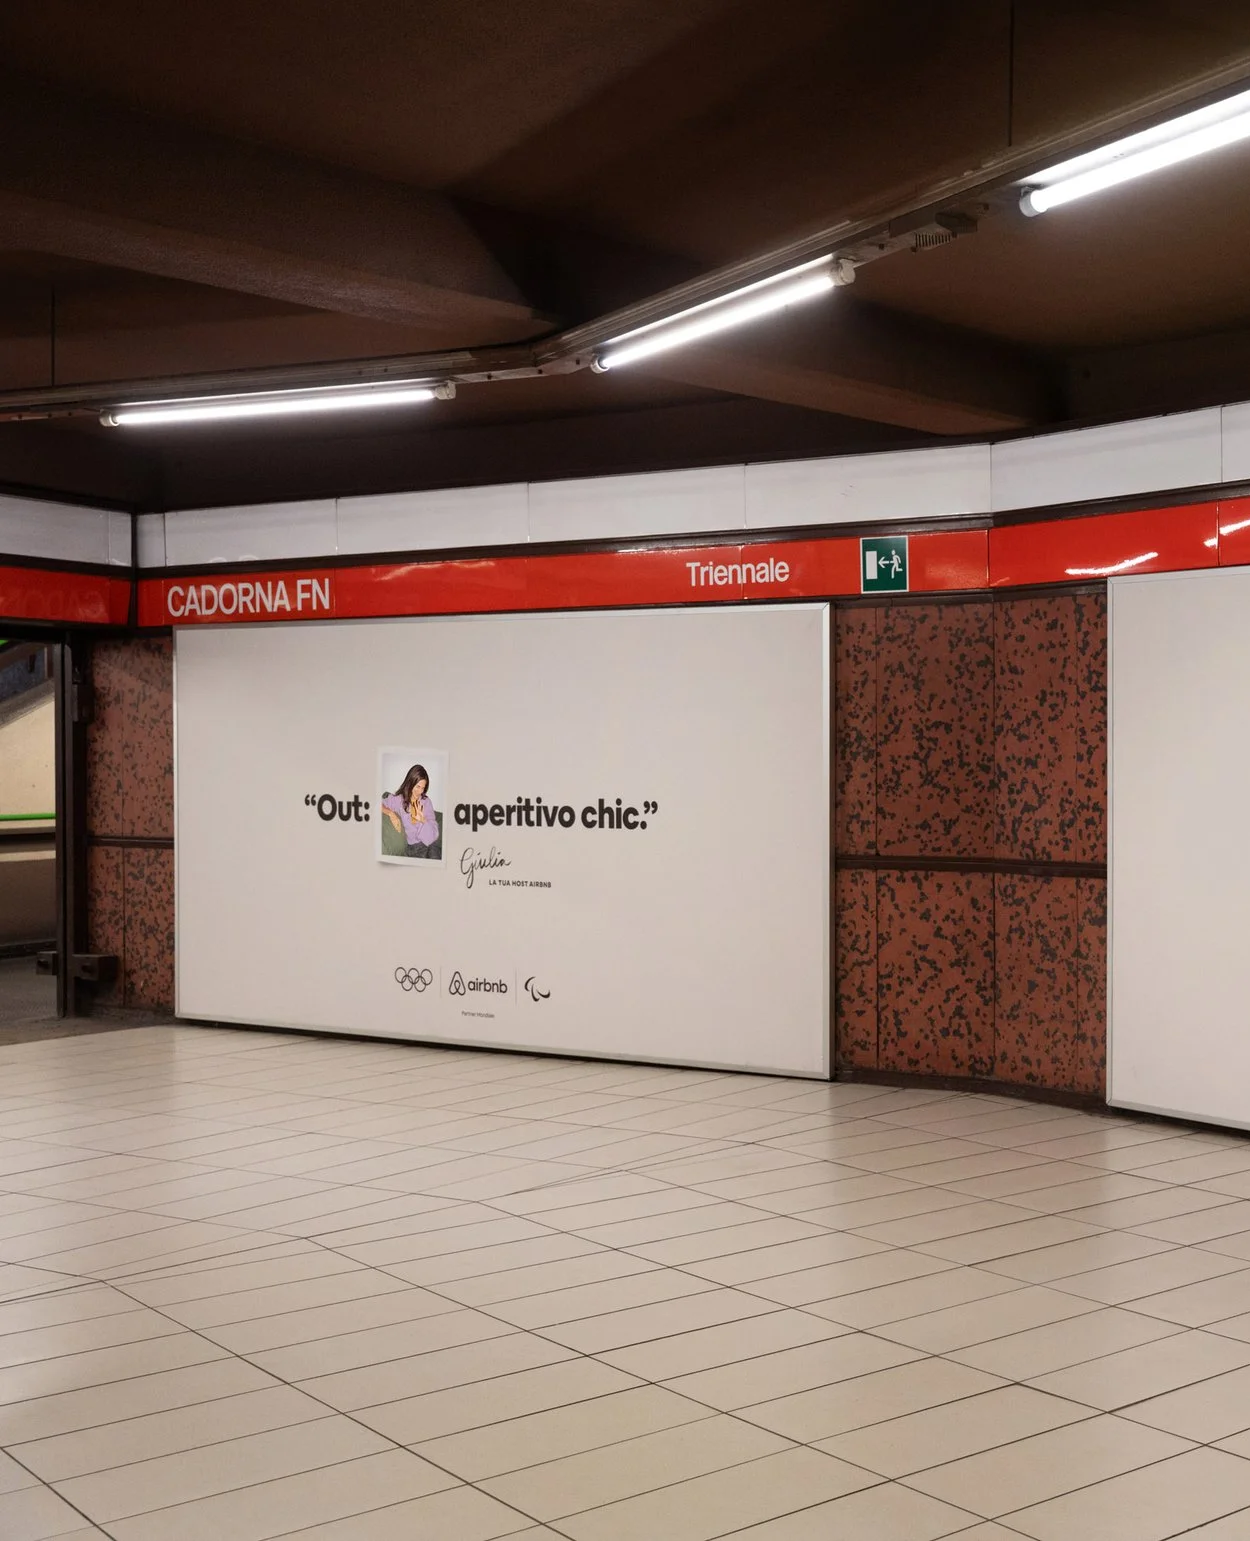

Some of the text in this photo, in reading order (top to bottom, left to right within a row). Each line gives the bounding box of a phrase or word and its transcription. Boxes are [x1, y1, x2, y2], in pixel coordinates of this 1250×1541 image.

[686, 558, 789, 586] Triennale
[168, 578, 329, 616] CADORNA FN
[305, 794, 658, 832] “Out: aperitivo chic.”
[459, 846, 511, 889] Giulia
[468, 978, 508, 994] airbnb
